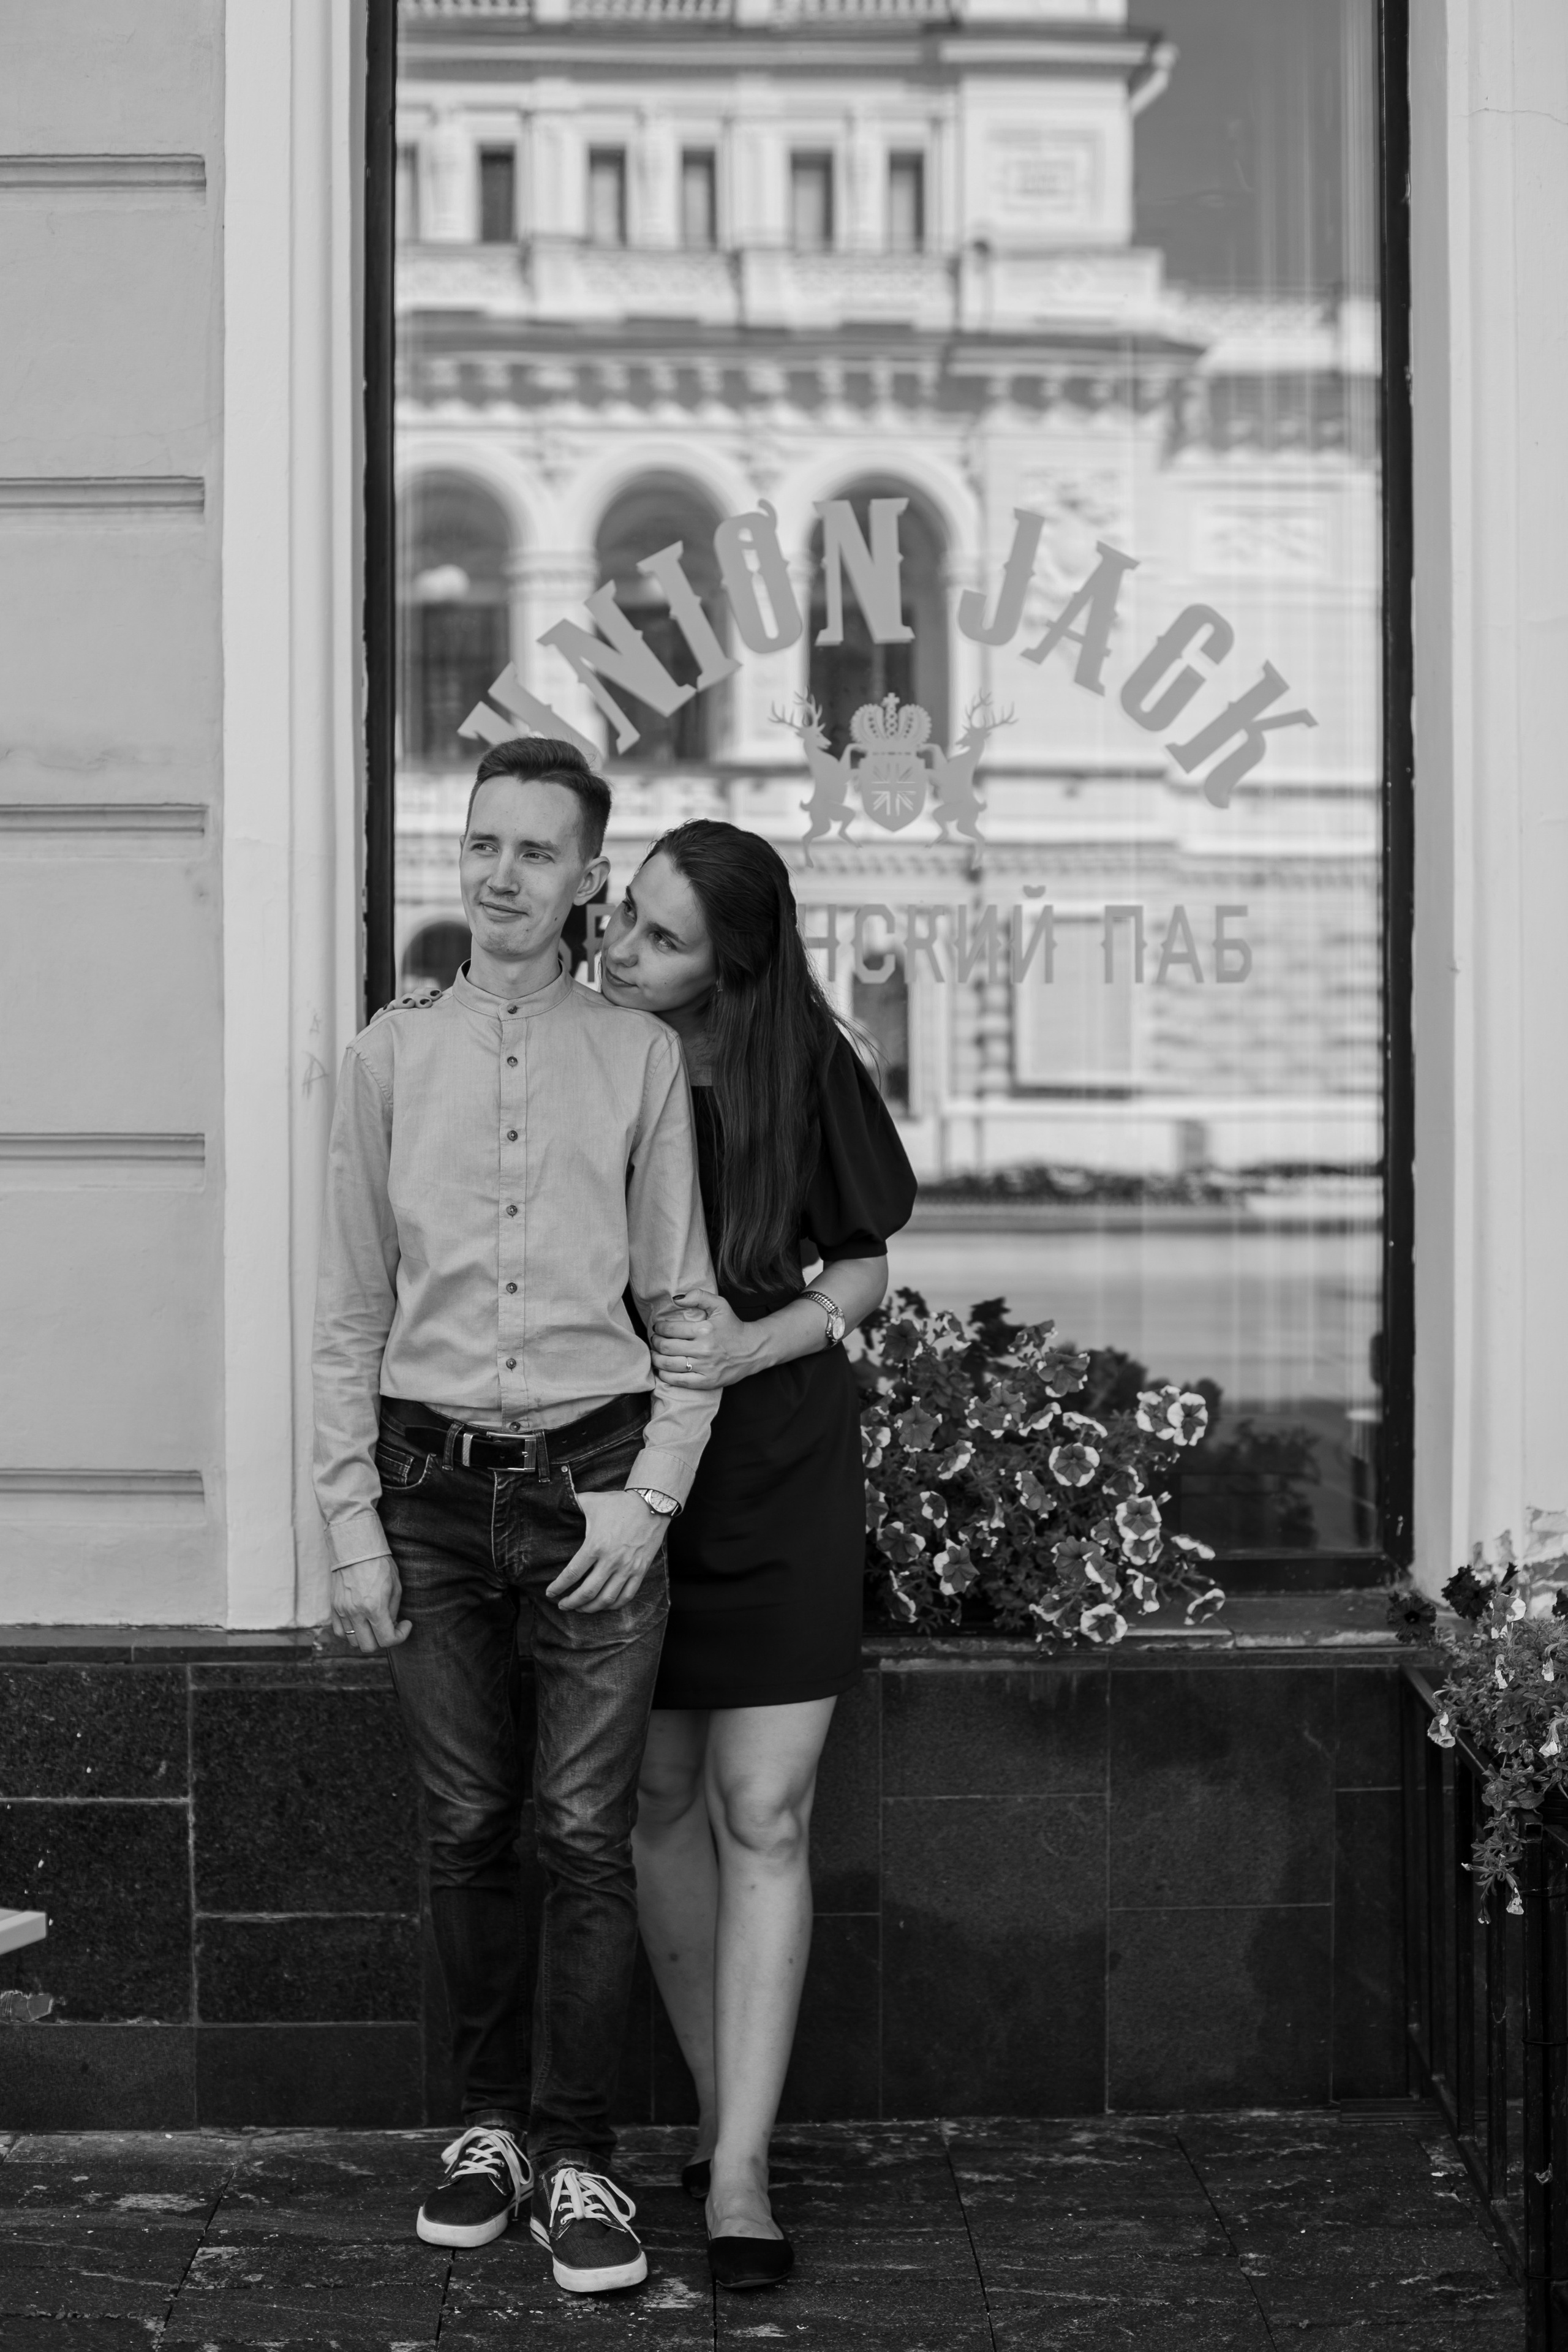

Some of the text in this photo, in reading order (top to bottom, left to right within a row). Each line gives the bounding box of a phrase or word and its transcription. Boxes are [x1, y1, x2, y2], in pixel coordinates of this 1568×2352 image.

[957, 507, 1319, 809] JACK
[559, 885, 1253, 984] РНСКИЙ ПАБ
